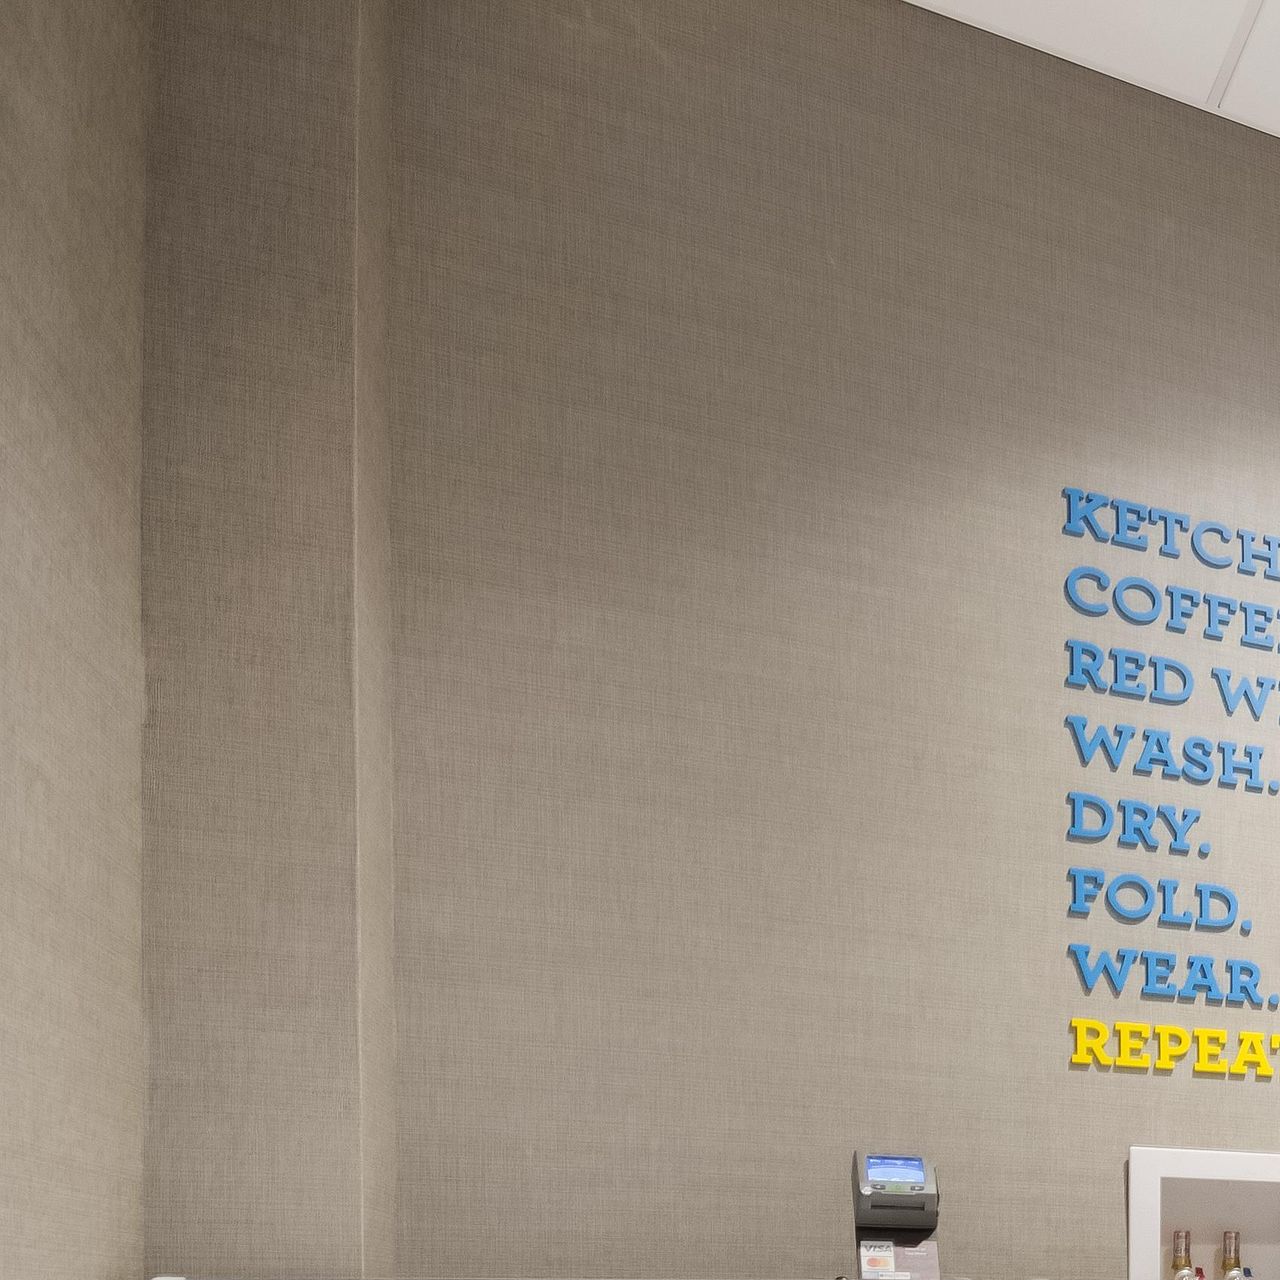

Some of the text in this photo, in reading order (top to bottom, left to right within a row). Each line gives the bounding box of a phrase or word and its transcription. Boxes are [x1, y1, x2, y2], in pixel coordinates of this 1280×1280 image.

[1064, 639, 1194, 706] RED
[1064, 714, 1280, 795] WASH.
[1065, 791, 1212, 859] DRY.
[1067, 867, 1253, 936] FOLD.
[1067, 944, 1280, 1012] WEAR.
